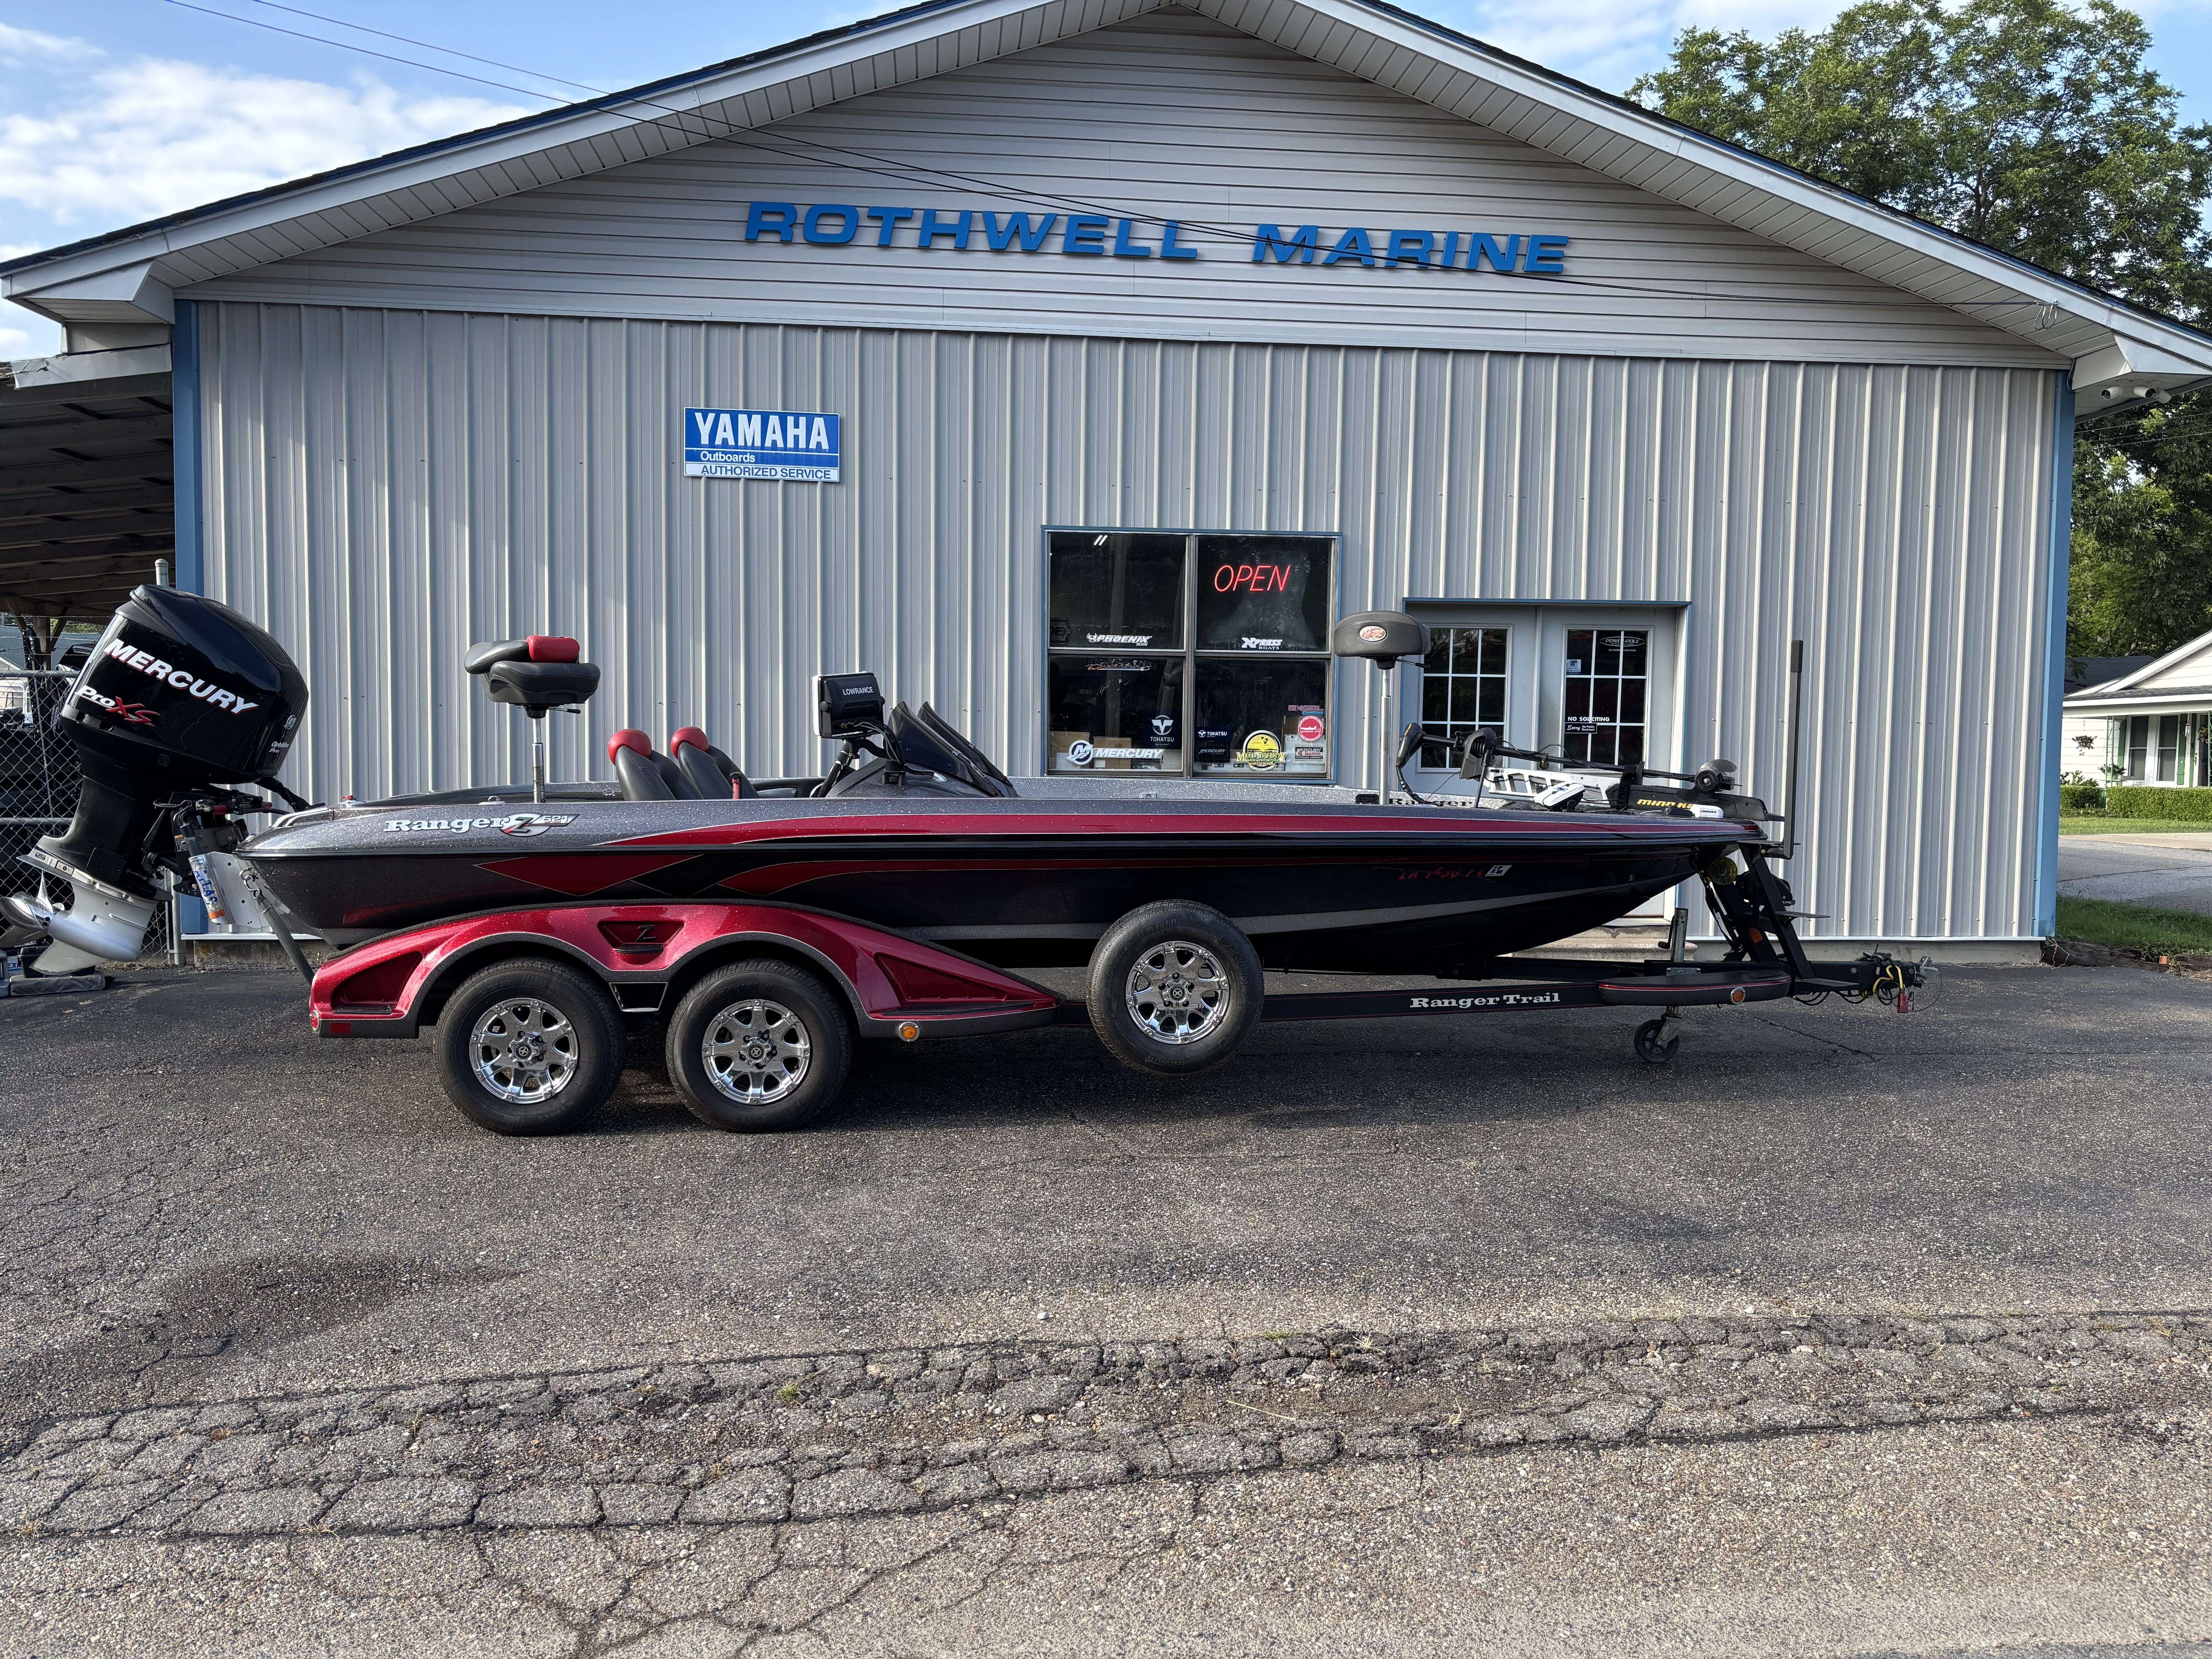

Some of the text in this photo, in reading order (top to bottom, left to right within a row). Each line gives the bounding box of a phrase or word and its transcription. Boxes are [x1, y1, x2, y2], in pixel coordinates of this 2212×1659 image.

[745, 201, 1569, 273] ROTHWELL MARINE
[695, 412, 829, 449] YAMAHA
[701, 451, 756, 462] Outboards
[701, 465, 831, 479] AUTHORIZED SERVICE
[1214, 565, 1291, 592] OPEN
[1097, 635, 1152, 643] PHOENIX
[103, 638, 259, 716] MERCURY
[842, 686, 874, 696] LOWRANCE
[1095, 749, 1164, 758] MERCURY
[1236, 752, 1287, 763] MUD BUDDY
[383, 816, 509, 833] Ranger
[1410, 993, 1560, 1008] Ranger Trail
